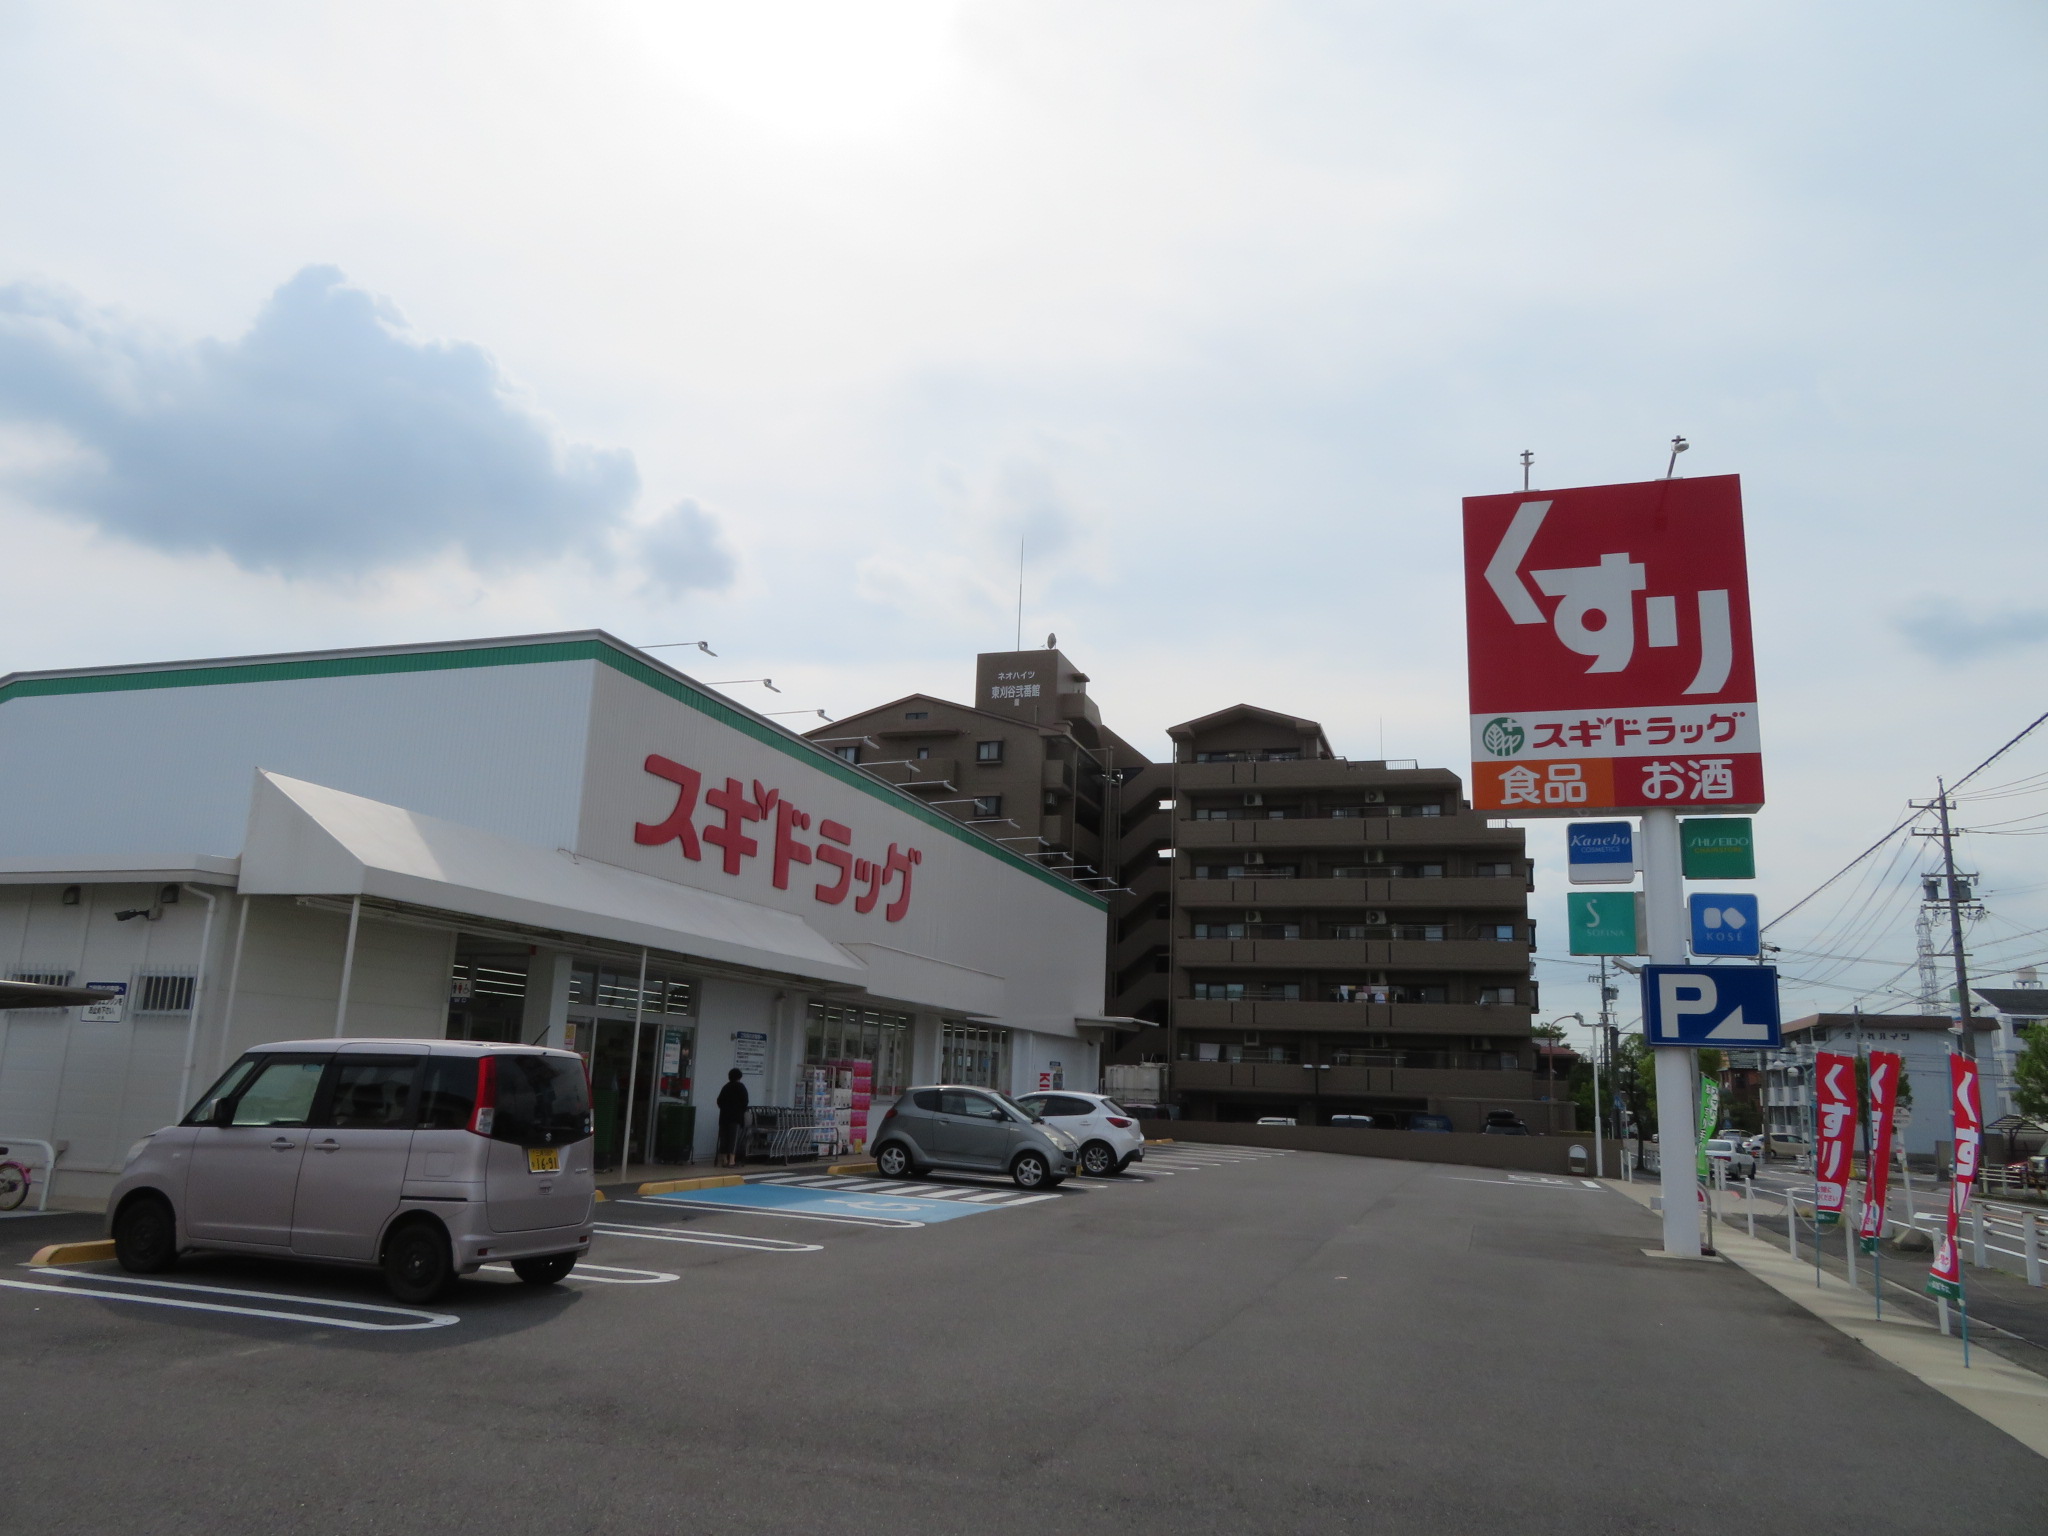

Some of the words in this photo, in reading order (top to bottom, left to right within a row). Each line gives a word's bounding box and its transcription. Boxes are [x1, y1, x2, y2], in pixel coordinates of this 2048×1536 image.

[1484, 500, 1733, 695] くすり
[998, 671, 1036, 681] ネオハイツ
[1532, 711, 1746, 749] スギドラッグ
[1498, 763, 1587, 804] 食品
[1641, 758, 1734, 800] お酒
[634, 753, 922, 923] スギドラッグ
[1570, 833, 1630, 847] Kanebo
[1688, 837, 1750, 847] SHISEIDO
[1586, 928, 1625, 937] SOFINA
[1658, 973, 1718, 1038] P
[1821, 1063, 1851, 1180] くすり
